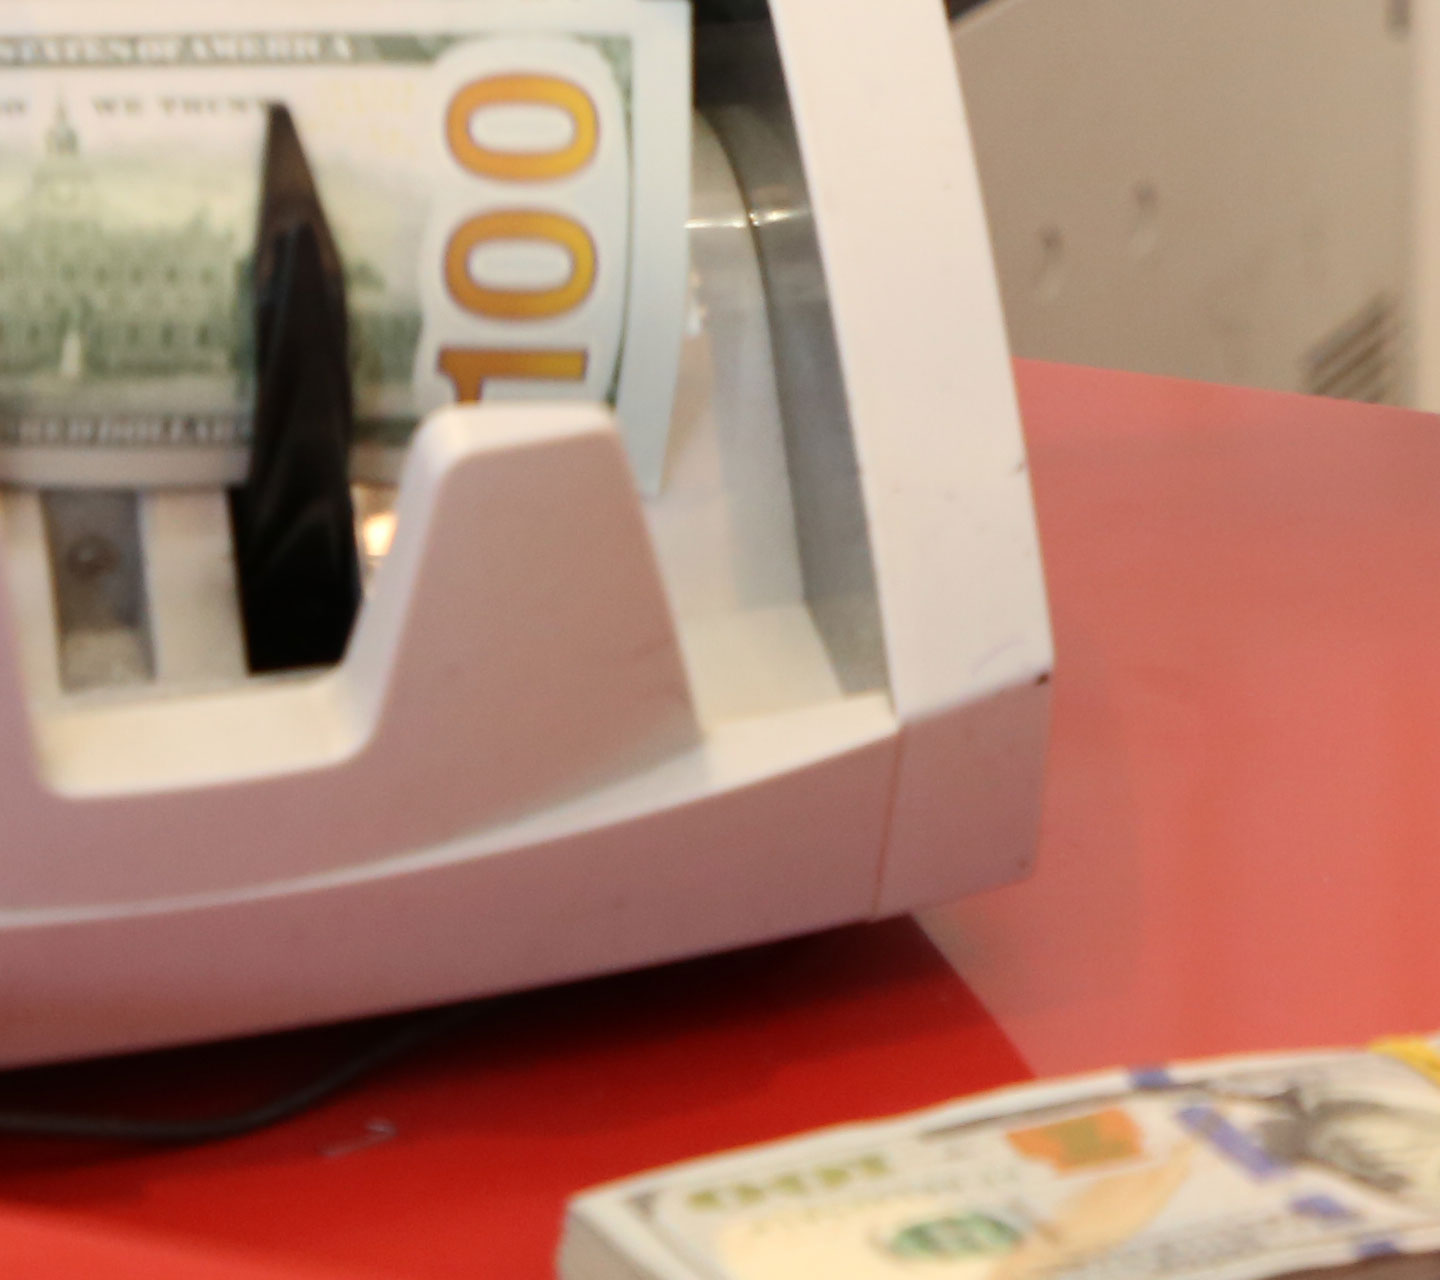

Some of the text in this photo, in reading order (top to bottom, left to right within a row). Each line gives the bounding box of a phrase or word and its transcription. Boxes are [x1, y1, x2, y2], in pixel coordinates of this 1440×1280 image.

[135, 39, 181, 63] OF
[186, 38, 354, 62] AMERICA
[437, 70, 600, 405] 100
